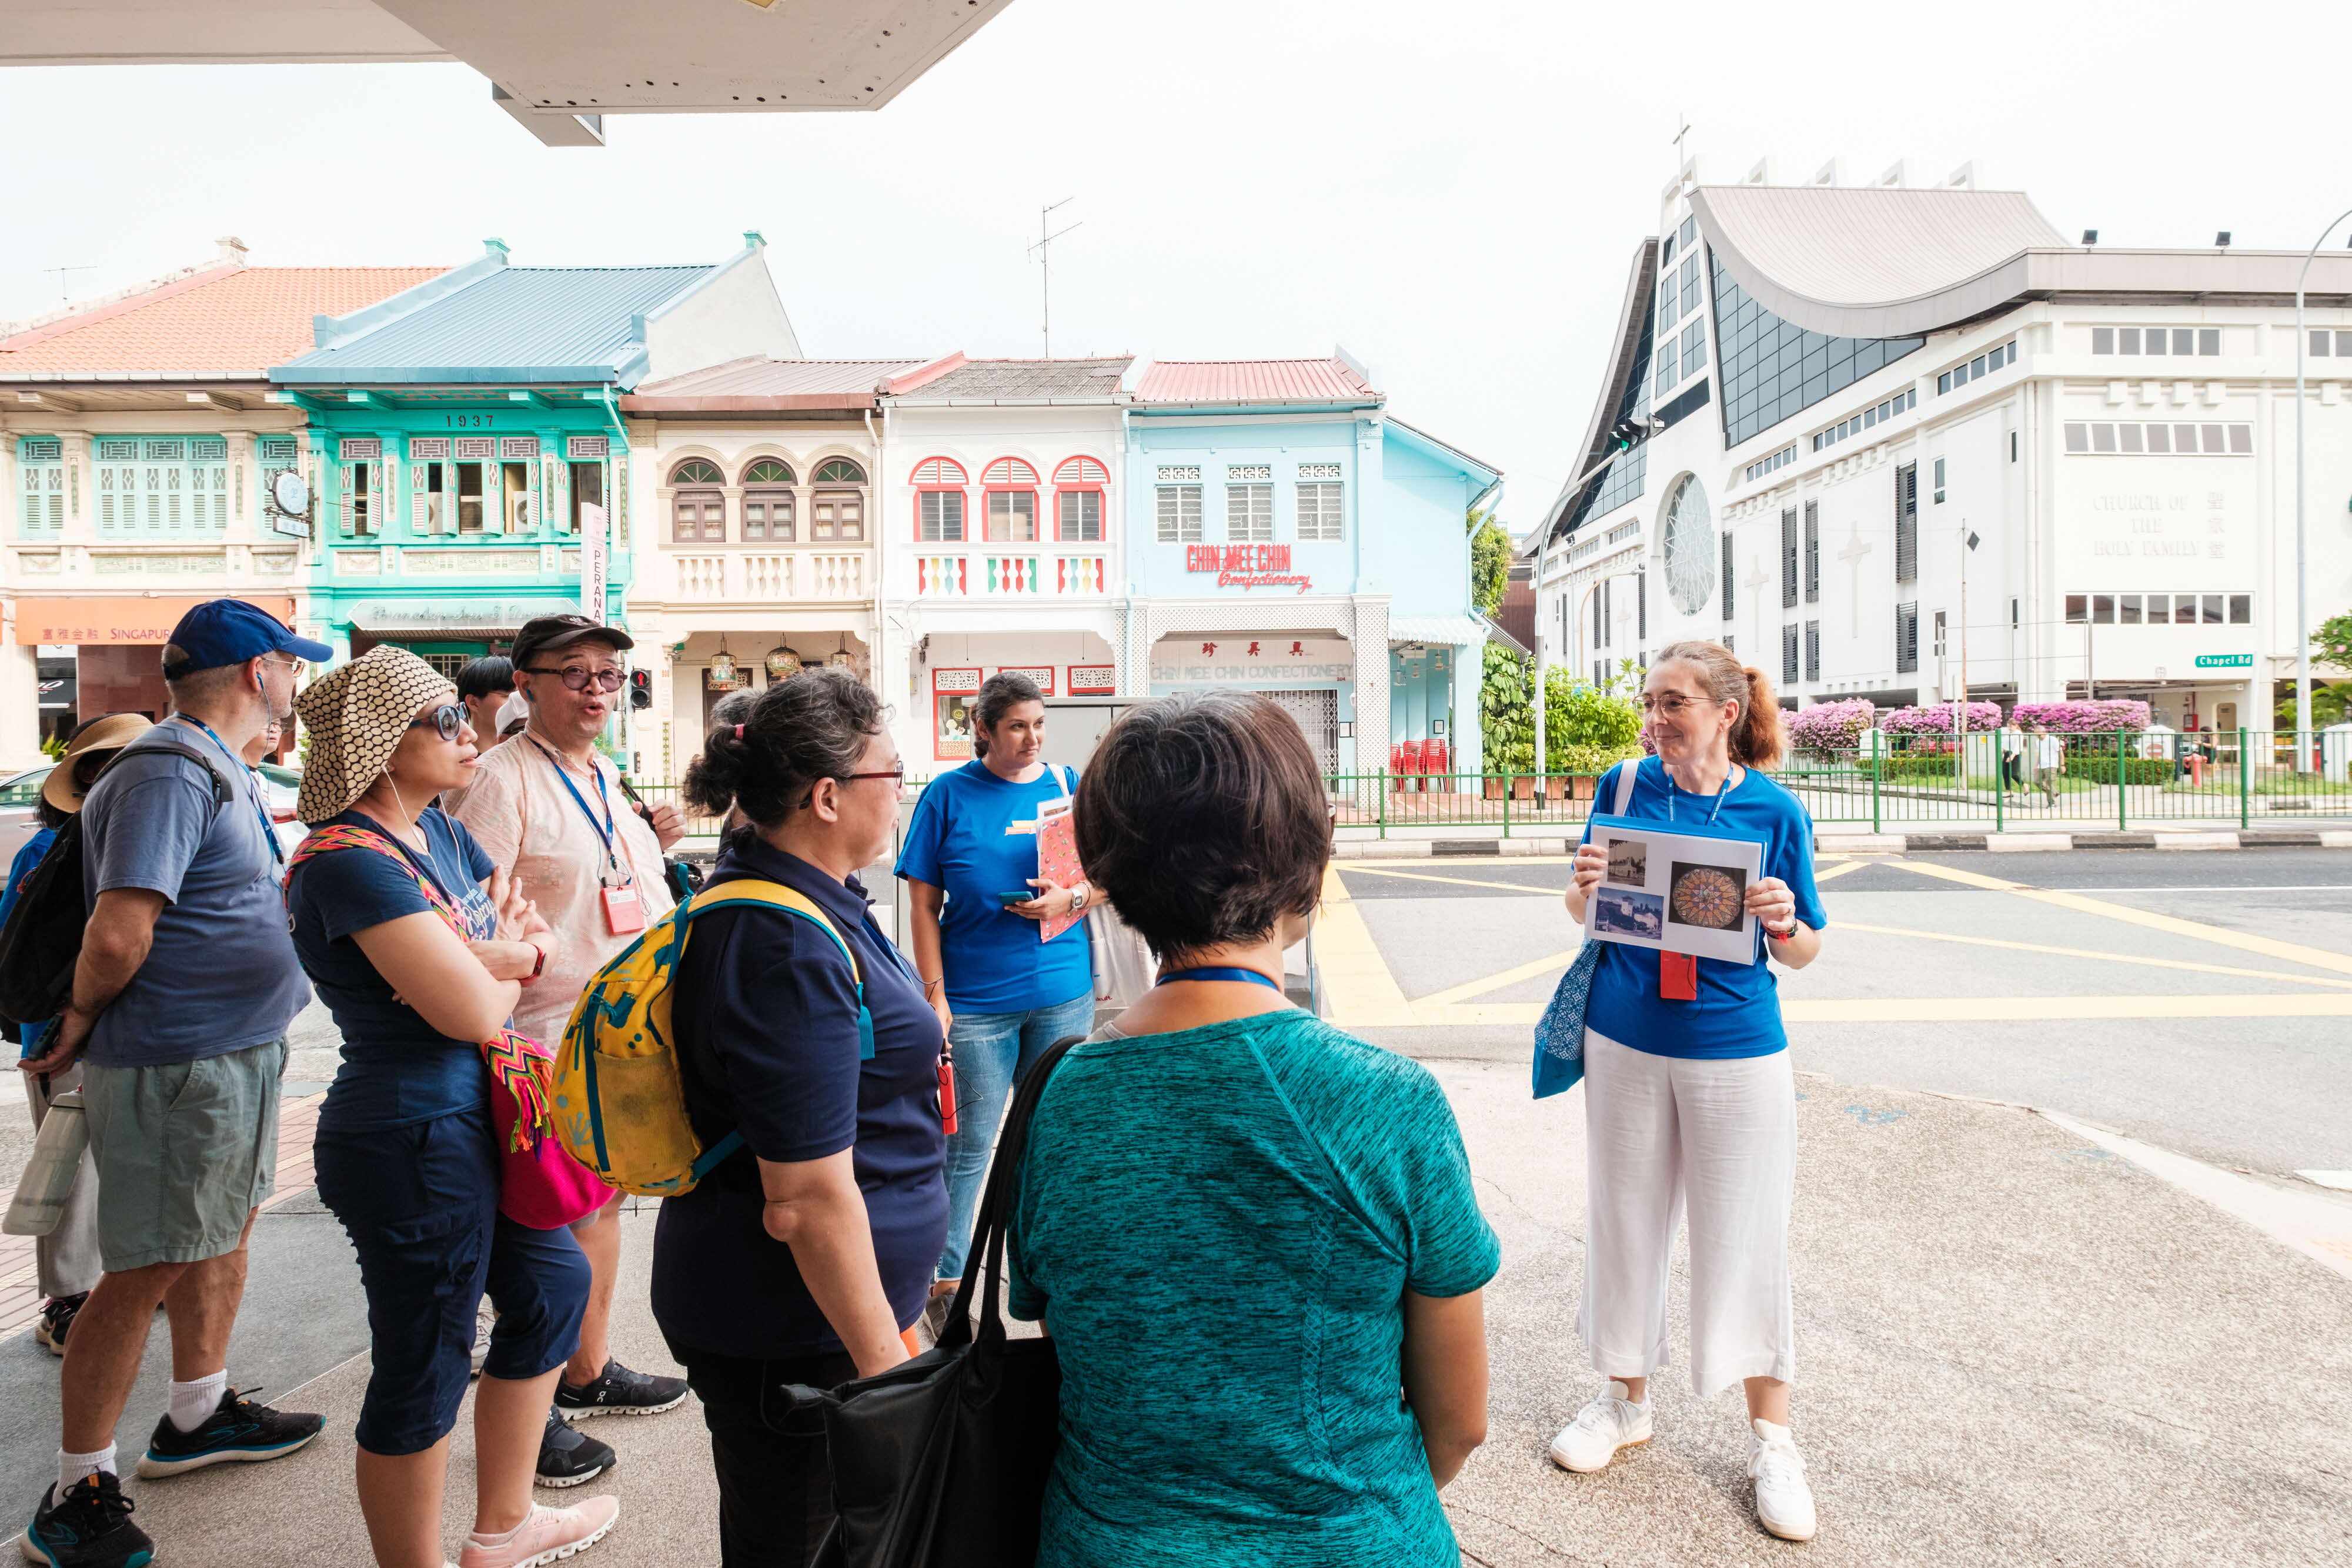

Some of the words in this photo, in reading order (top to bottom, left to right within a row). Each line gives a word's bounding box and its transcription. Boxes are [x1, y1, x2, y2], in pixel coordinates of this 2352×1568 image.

[447, 415, 493, 427] 1937
[2093, 494, 2161, 510] CHURCH
[2130, 517, 2163, 534] THE
[2093, 540, 2133, 556] HOLY
[2142, 540, 2201, 556] FAMILY
[1187, 544, 1220, 571] CHIN
[1224, 544, 1254, 571] MEE
[1258, 544, 1291, 571] CHIN
[1218, 569, 1312, 594] Confectionery
[2200, 656, 2234, 666] Chapel
[2238, 655, 2251, 664] Rd
[1151, 666, 1180, 680] CHIN
[1184, 666, 1211, 680] MEE
[1215, 666, 1245, 679] CHIN
[1248, 664, 1353, 678] CONFECTIONERY
